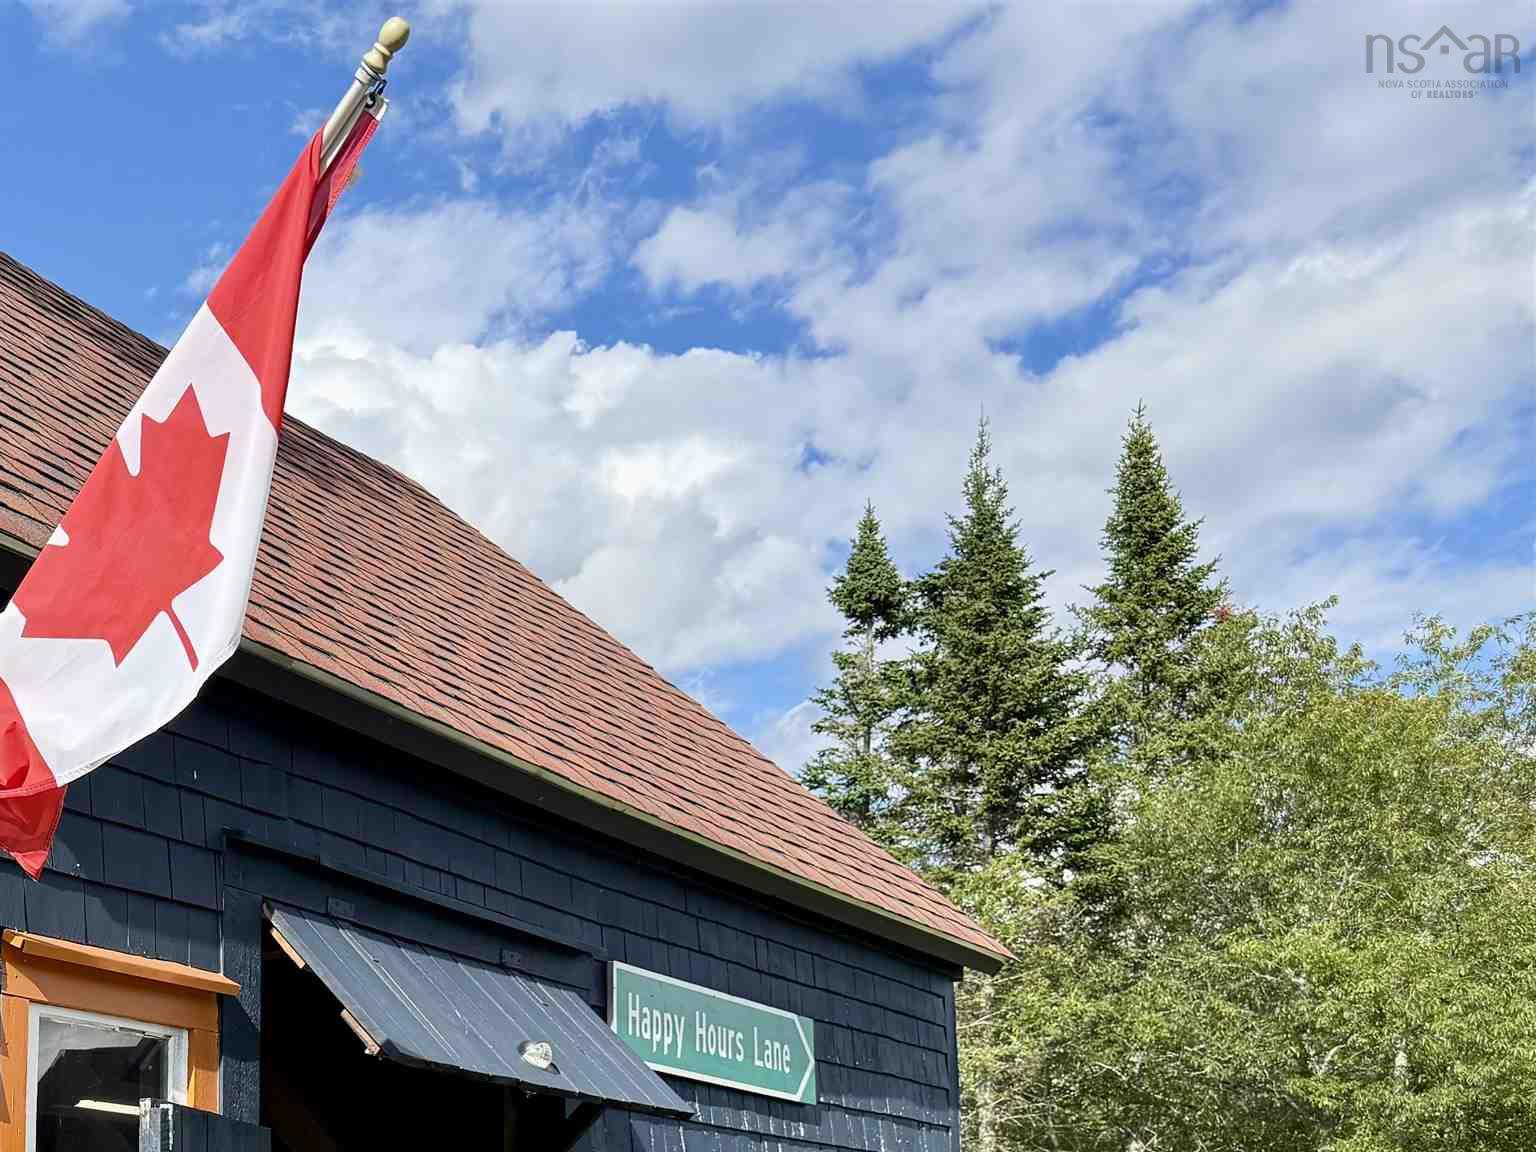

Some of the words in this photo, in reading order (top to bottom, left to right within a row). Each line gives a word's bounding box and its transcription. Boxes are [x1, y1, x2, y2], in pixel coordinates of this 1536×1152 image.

[628, 991, 686, 1059] Happy
[695, 1010, 745, 1063] Hours
[753, 1026, 792, 1074] Lane
